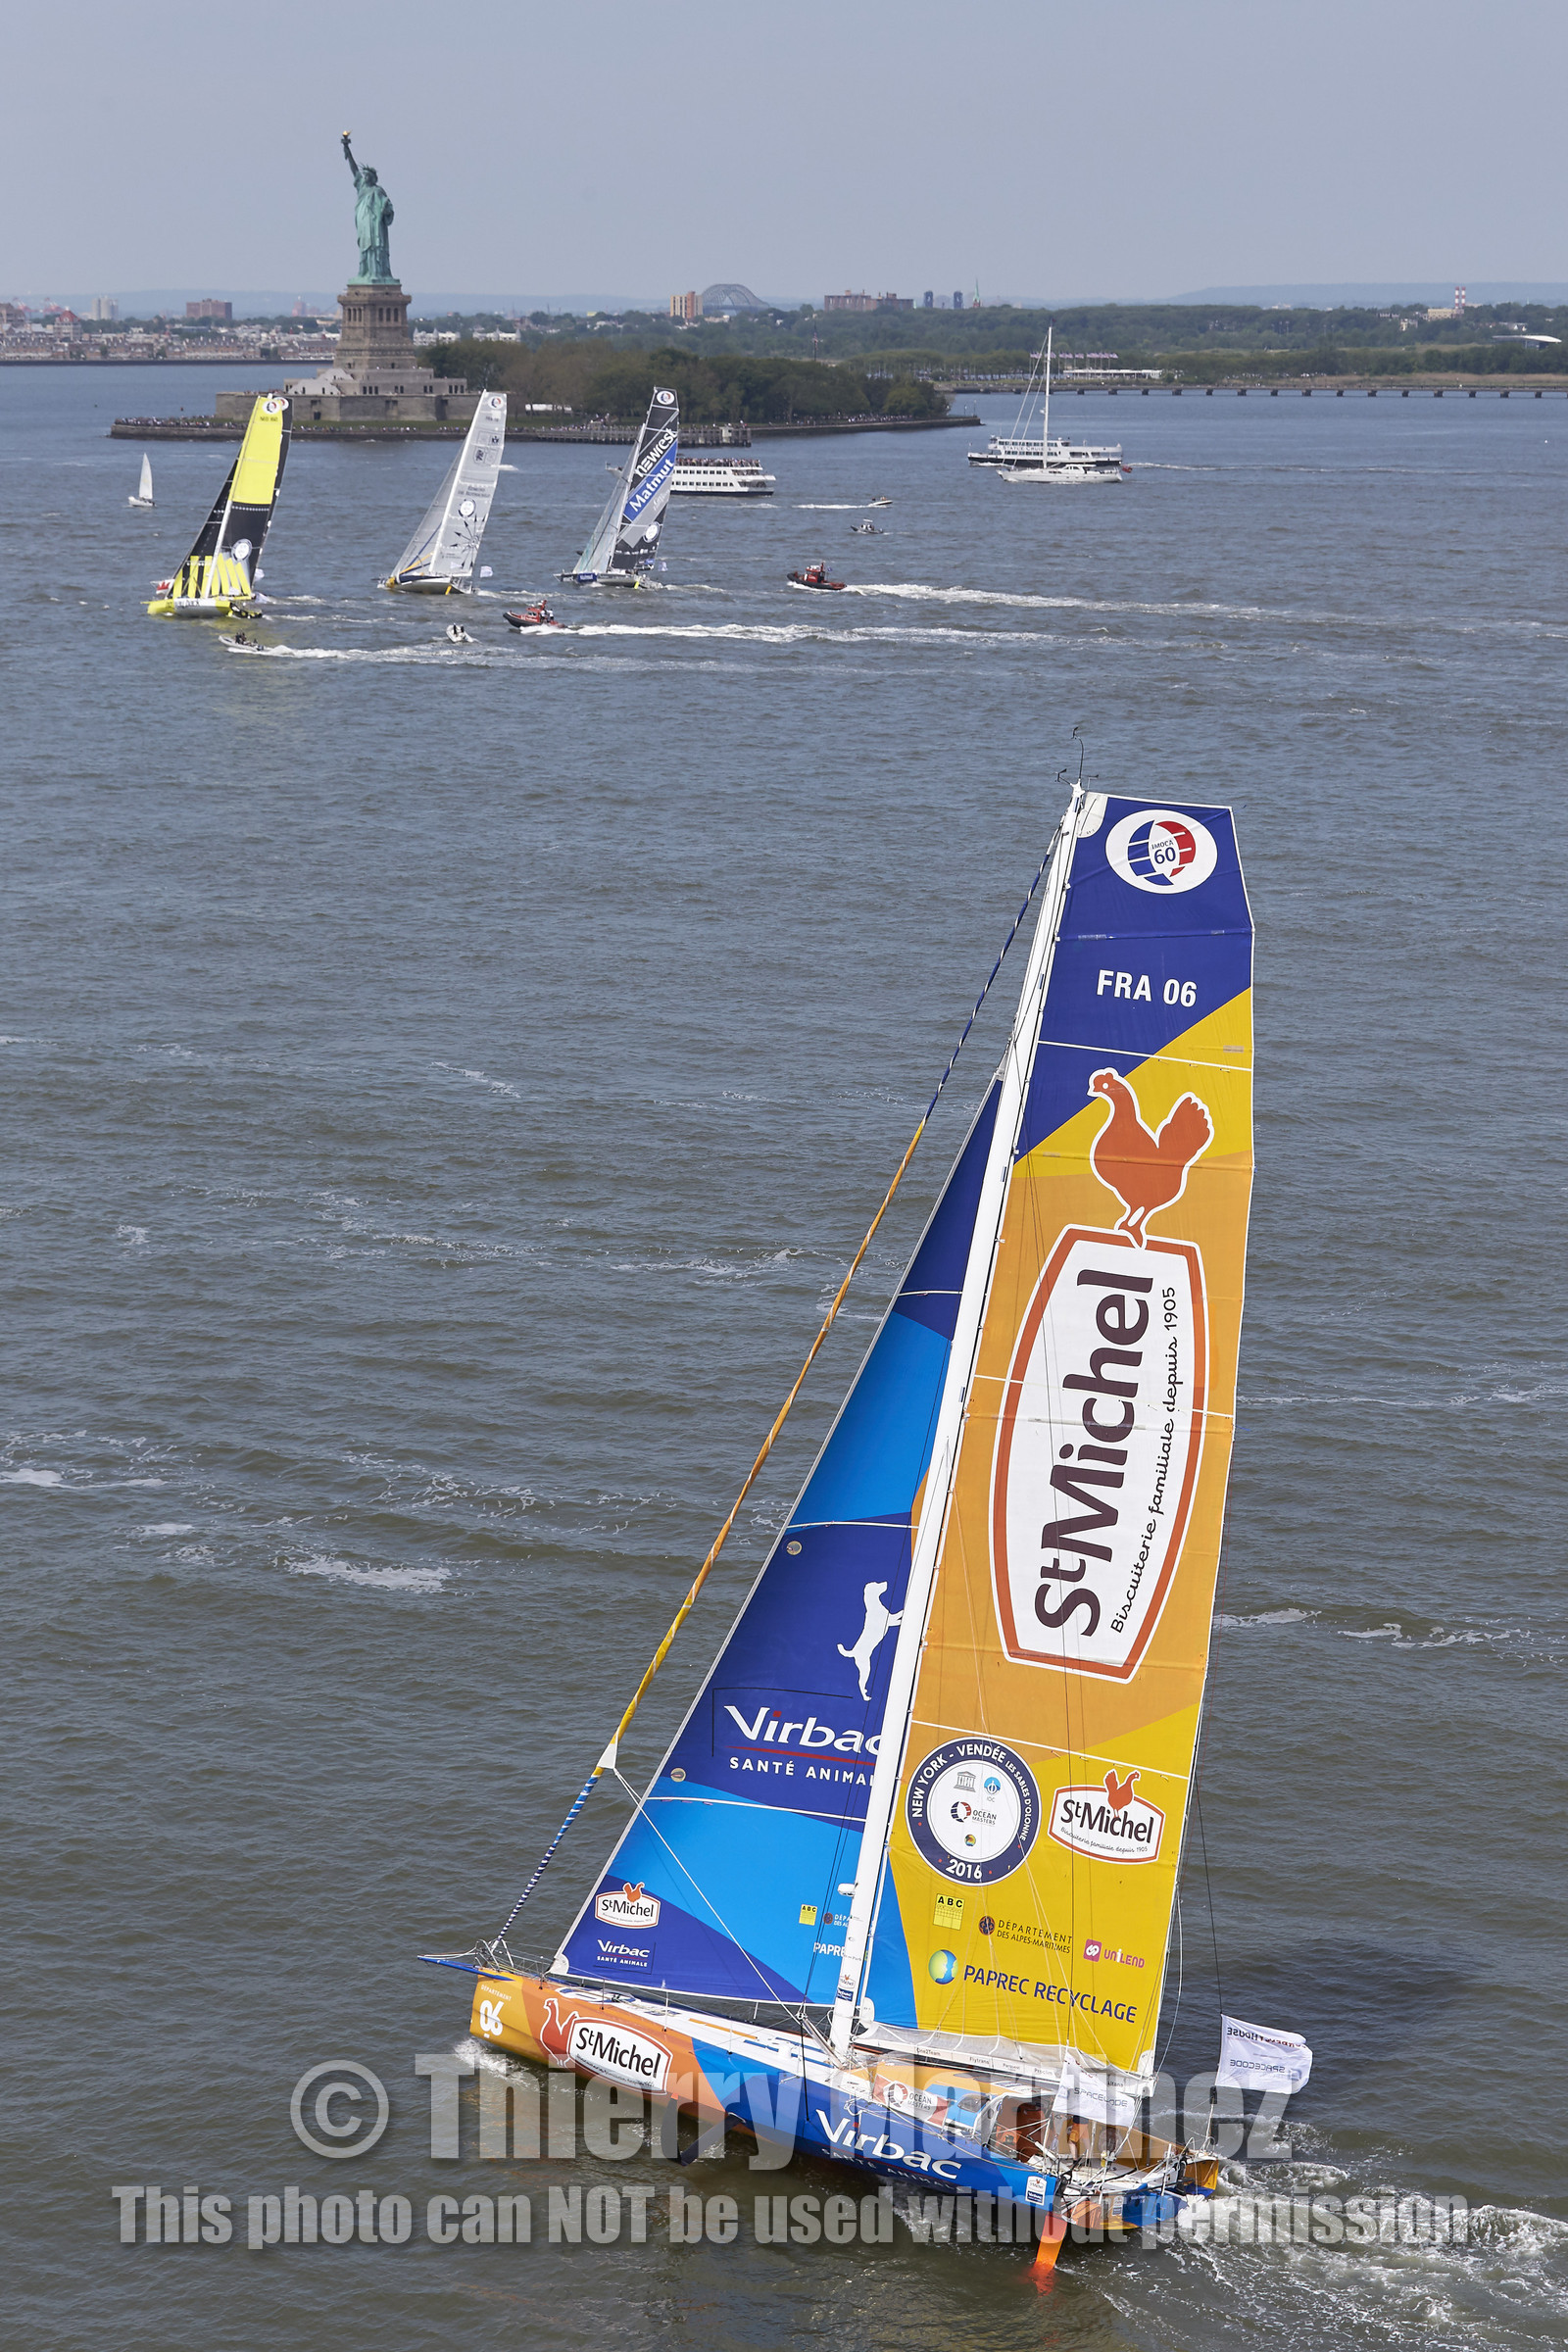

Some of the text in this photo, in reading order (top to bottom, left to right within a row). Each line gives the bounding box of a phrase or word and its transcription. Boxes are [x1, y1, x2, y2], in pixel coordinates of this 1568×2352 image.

[629, 458, 674, 512] Matmut
[1152, 839, 1174, 850] IMOCA
[1153, 847, 1176, 864] 60
[1097, 969, 1197, 1007] FRA 06
[1110, 1287, 1183, 1633] Biscuiterie familiale depuis 1905
[956, 1743, 1007, 1764] VENDÉE
[729, 1756, 874, 1787] SANTÉ ANIMA
[917, 1753, 948, 1786] YORK
[1004, 1760, 1017, 1774] LES
[1013, 1770, 1030, 1798] SABLES
[911, 1787, 926, 1818] NEW
[972, 1809, 998, 1820] OCEAN
[972, 1816, 996, 1826] MASTERS
[1020, 1798, 1032, 1841] D'OLONNE
[946, 1859, 983, 1880] 2016
[997, 1930, 1070, 1954] DES ALPES-MARITIMES
[998, 1919, 1072, 1944] DÉPARTEMENT
[597, 1939, 650, 1957] Virbac
[812, 1941, 845, 1958] PAPRE
[963, 1965, 1138, 2024] PAPREC RECYCLAGE
[479, 2000, 505, 2036] 06
[908, 2092, 932, 2105] OCEAN
[815, 2108, 962, 2180] Virbac
